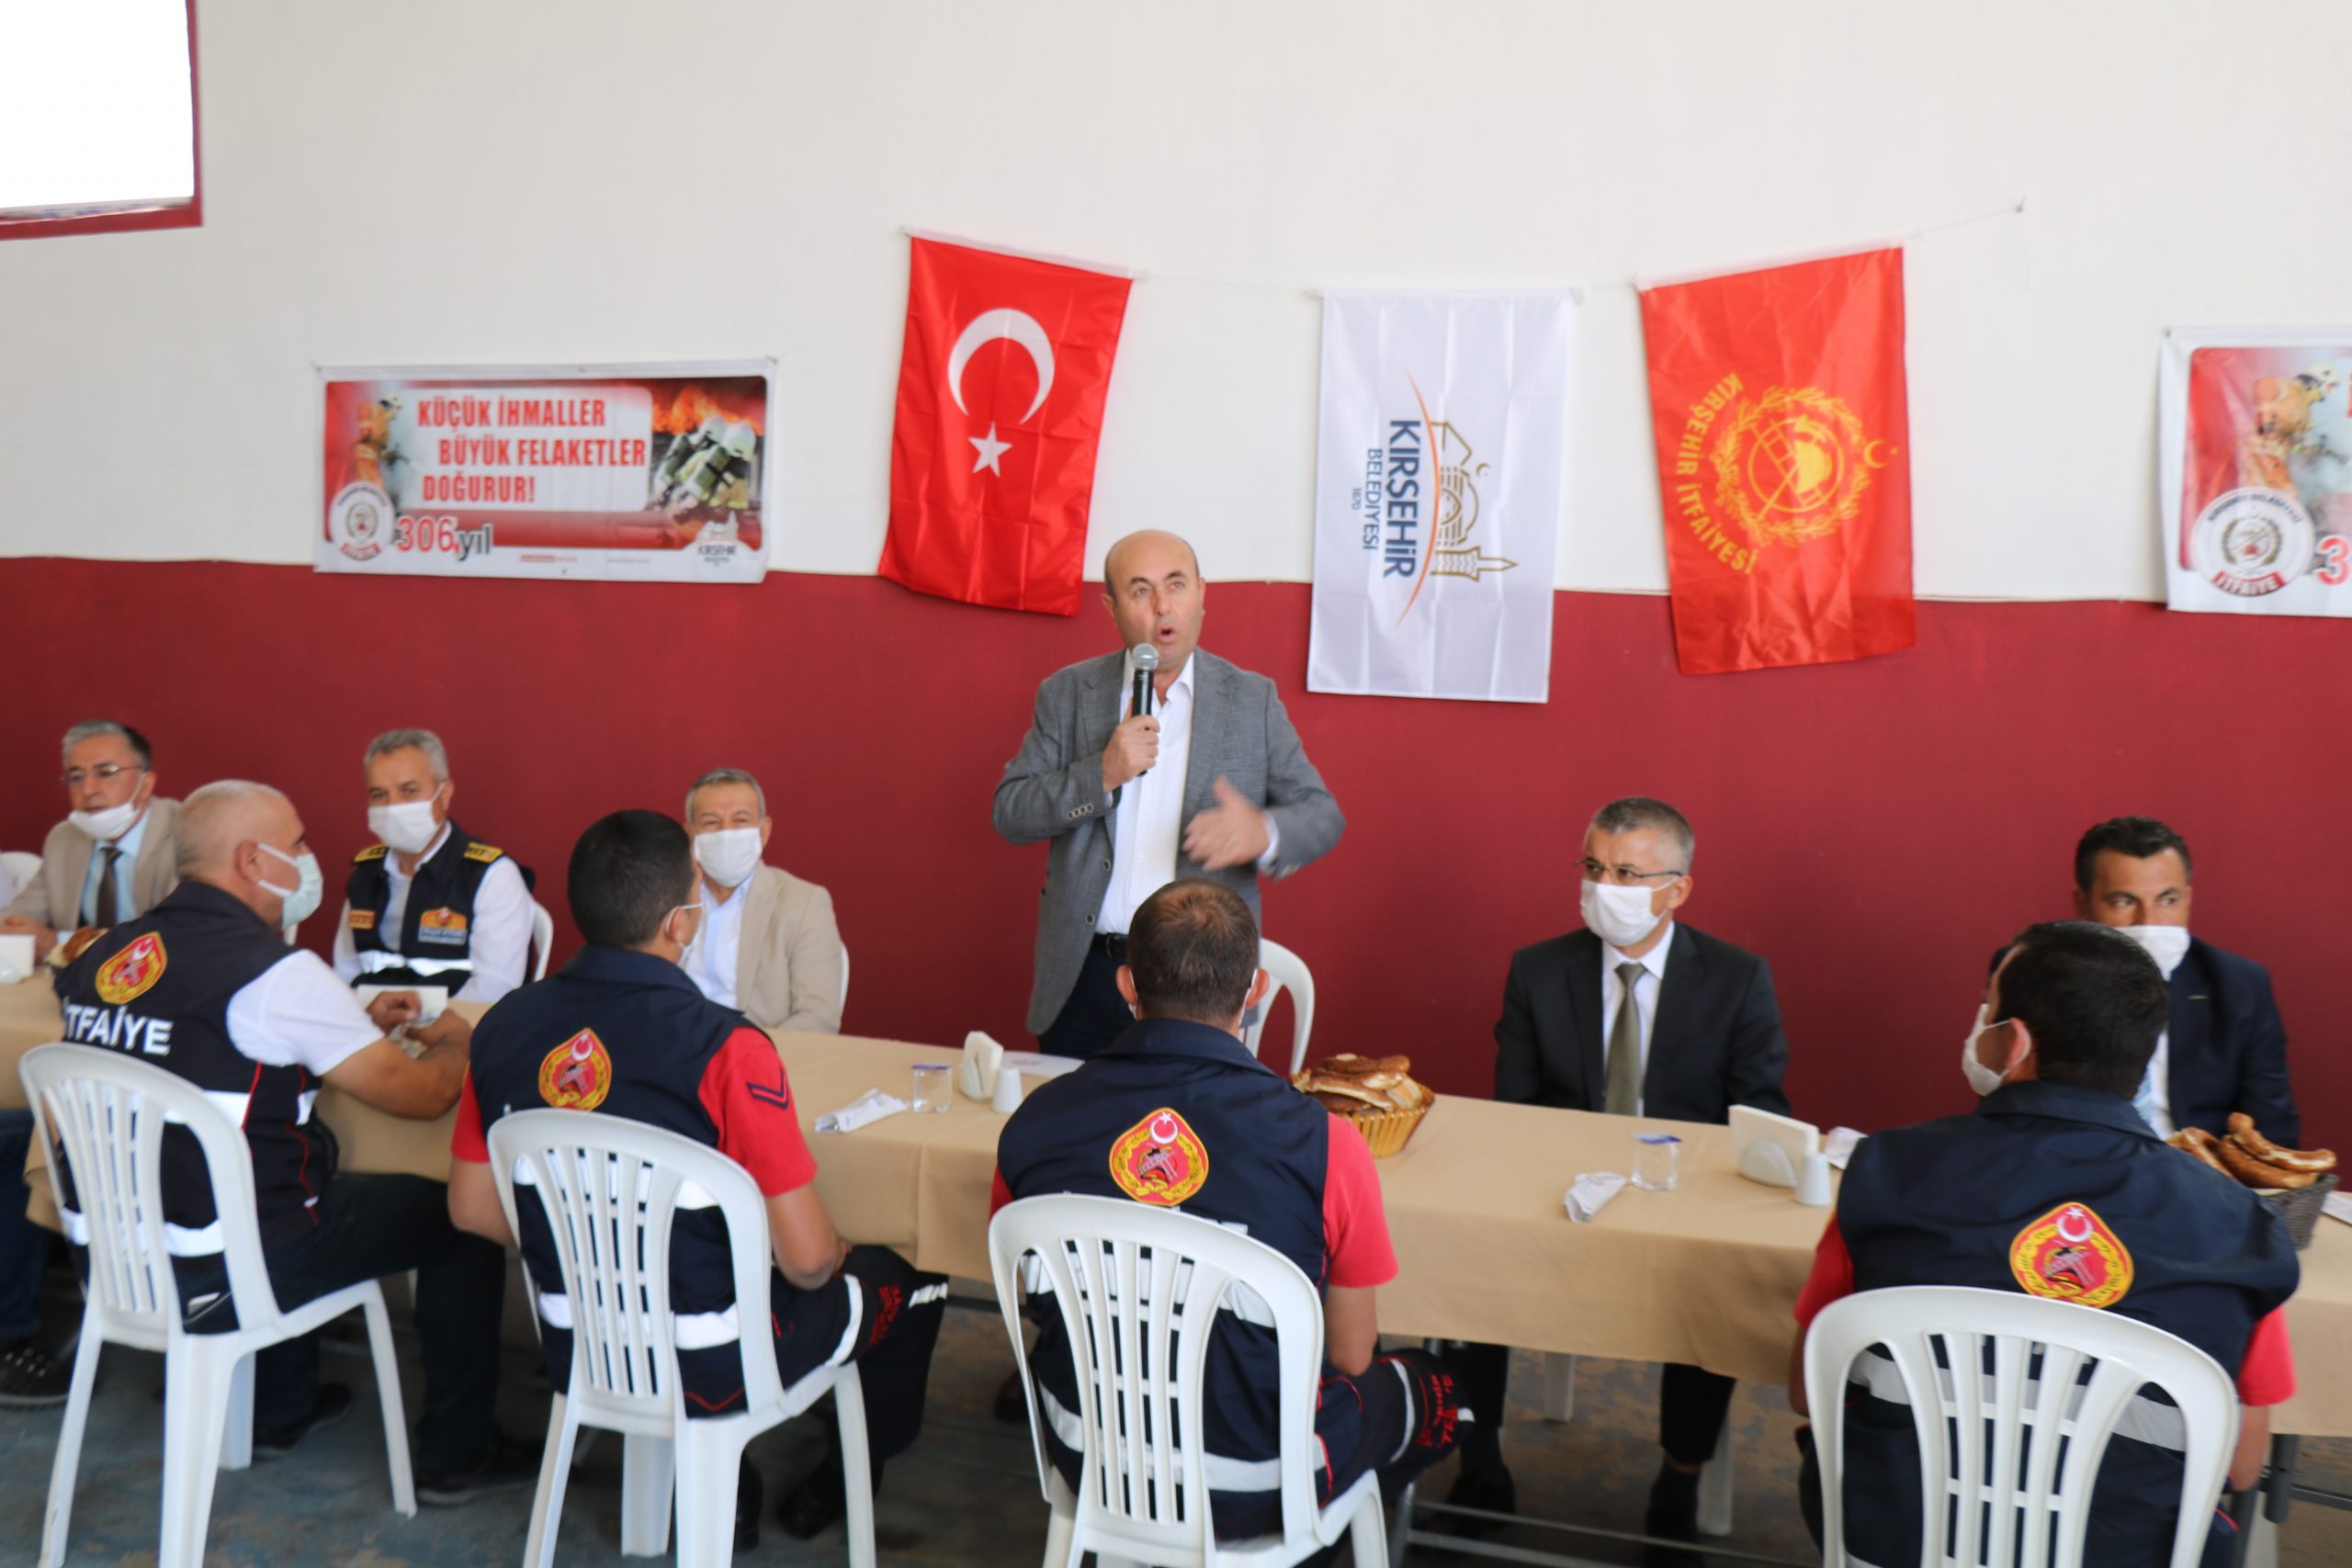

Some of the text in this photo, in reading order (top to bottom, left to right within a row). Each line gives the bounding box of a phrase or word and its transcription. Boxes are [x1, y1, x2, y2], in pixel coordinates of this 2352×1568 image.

[417, 395, 606, 433] KÜÇÜK İHMALLER
[438, 434, 647, 467] BÜYÜK FELAKETLER
[423, 469, 536, 502] DOĞURUR!
[1677, 372, 1758, 574] KIRŞEHİR İTFAİYESİ
[1383, 420, 1421, 579] KIRŞEHİR
